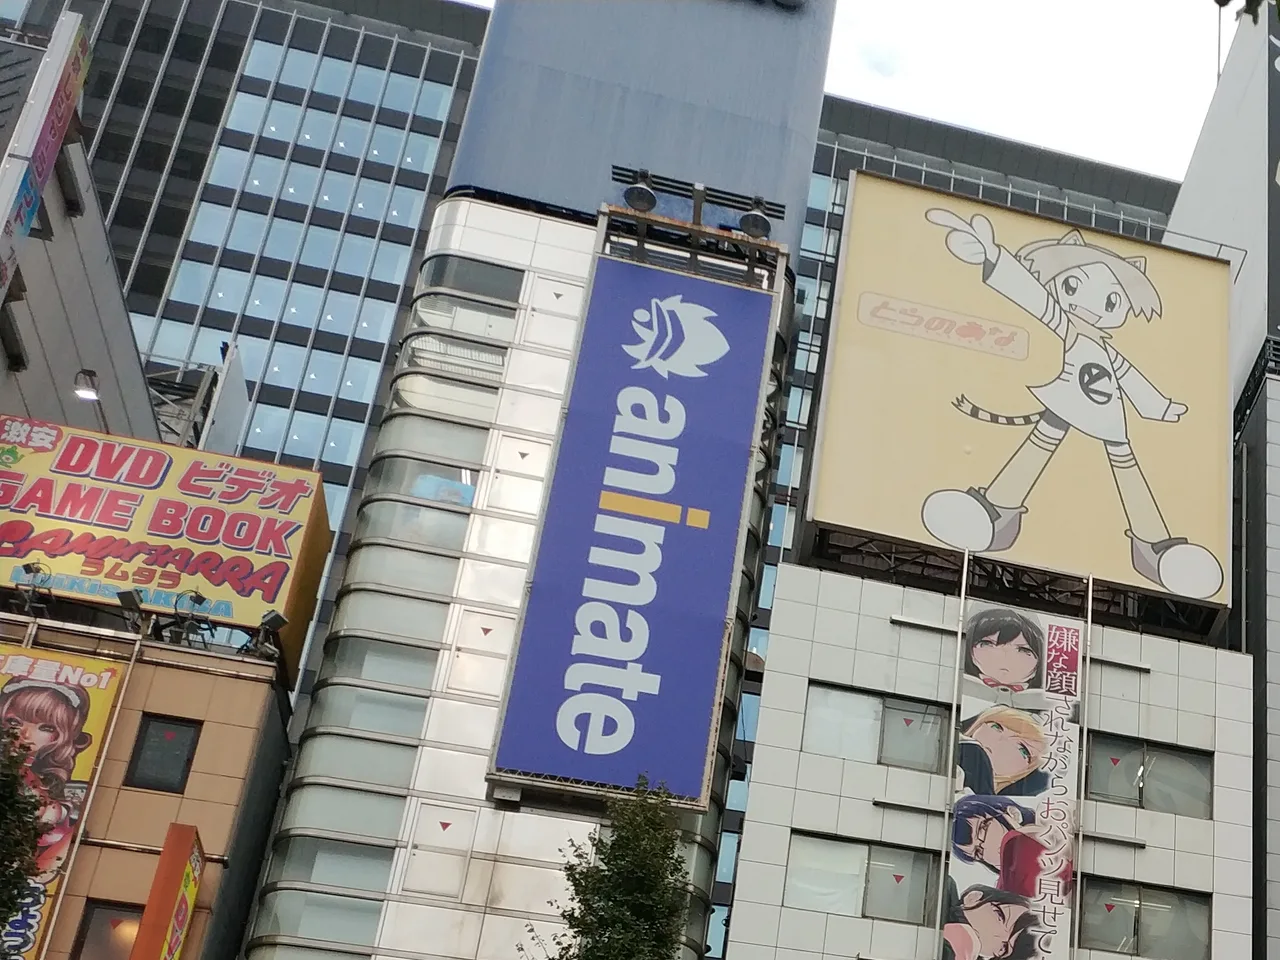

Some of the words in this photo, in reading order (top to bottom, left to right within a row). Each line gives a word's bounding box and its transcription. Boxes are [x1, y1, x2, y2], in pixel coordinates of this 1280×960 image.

[1, 419, 58, 450] 激安
[51, 434, 173, 490] DVD
[177, 459, 313, 514] ビデオ
[0, 472, 144, 531] GAME
[147, 497, 304, 560] BOOK
[80, 557, 182, 589] ラムタラ
[556, 385, 711, 757] animate
